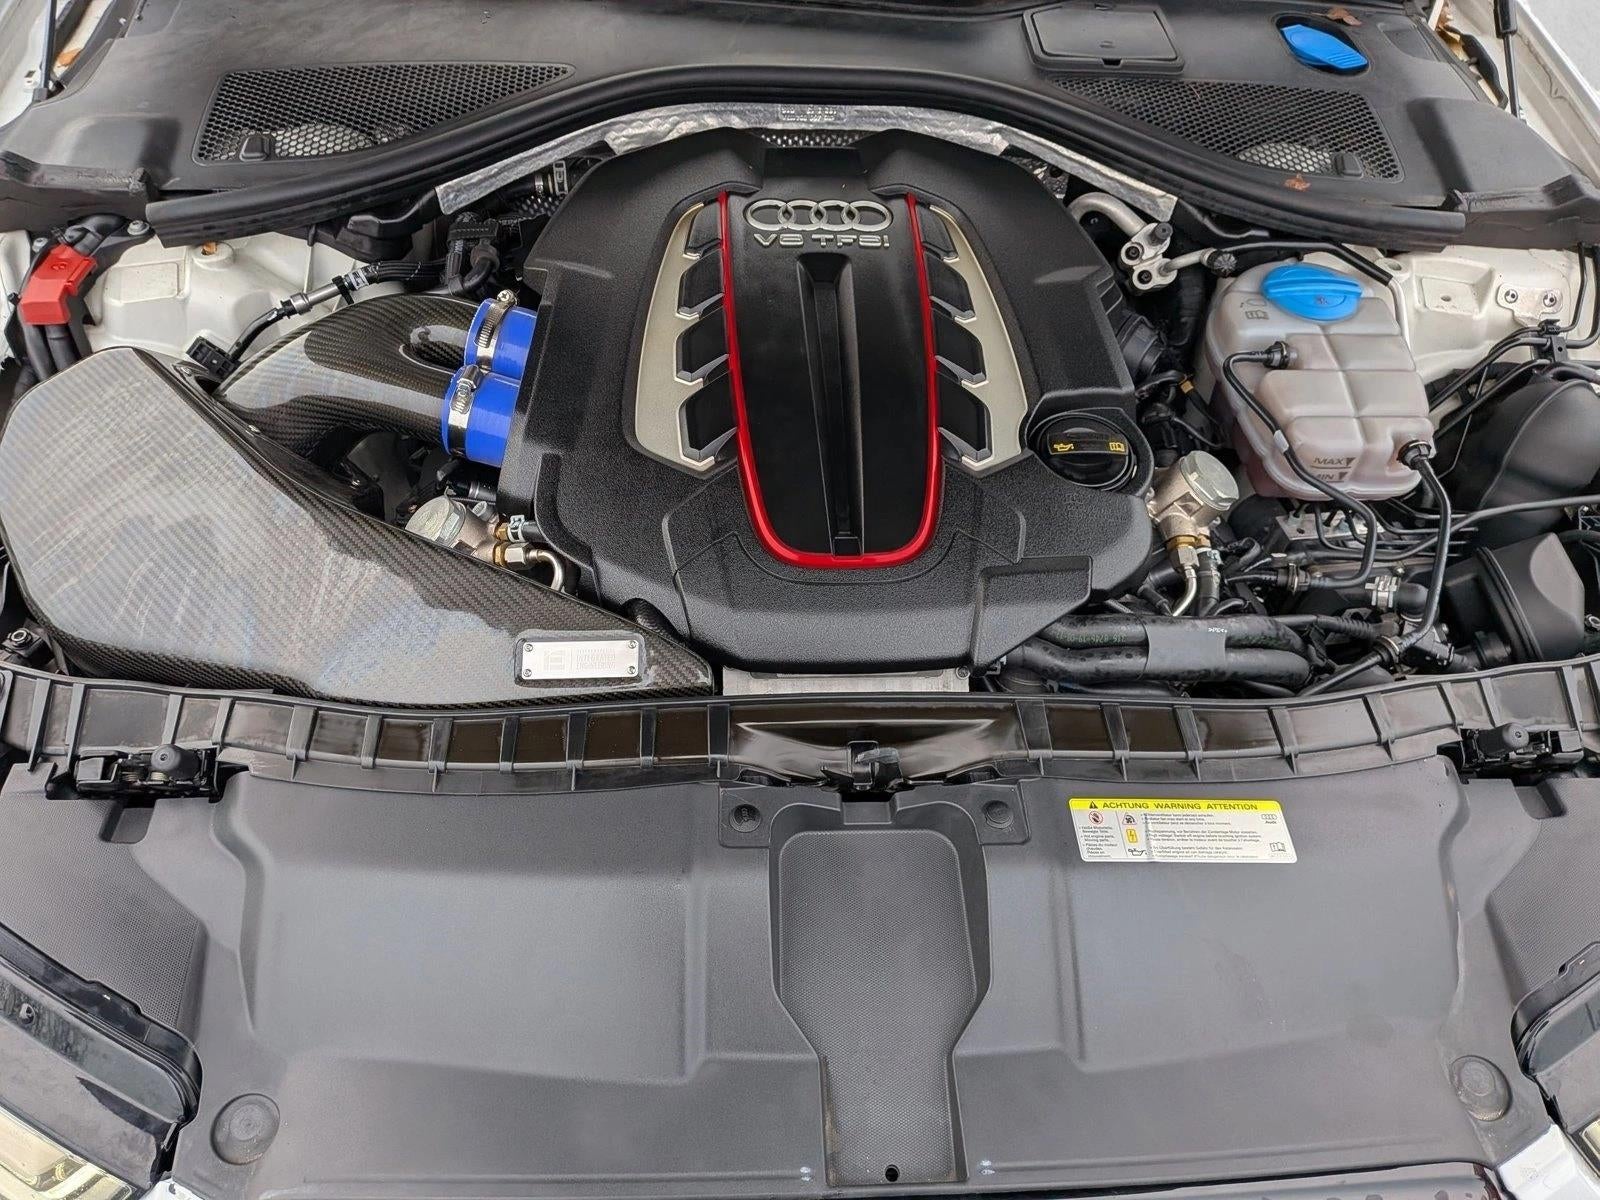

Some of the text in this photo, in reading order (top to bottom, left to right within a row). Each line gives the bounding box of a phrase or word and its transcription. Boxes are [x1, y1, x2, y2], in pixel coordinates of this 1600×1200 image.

[753, 233, 804, 248] V8
[1313, 457, 1344, 465] MAX
[1102, 801, 1149, 809] ACHTUNG
[1153, 802, 1201, 810] WARNING
